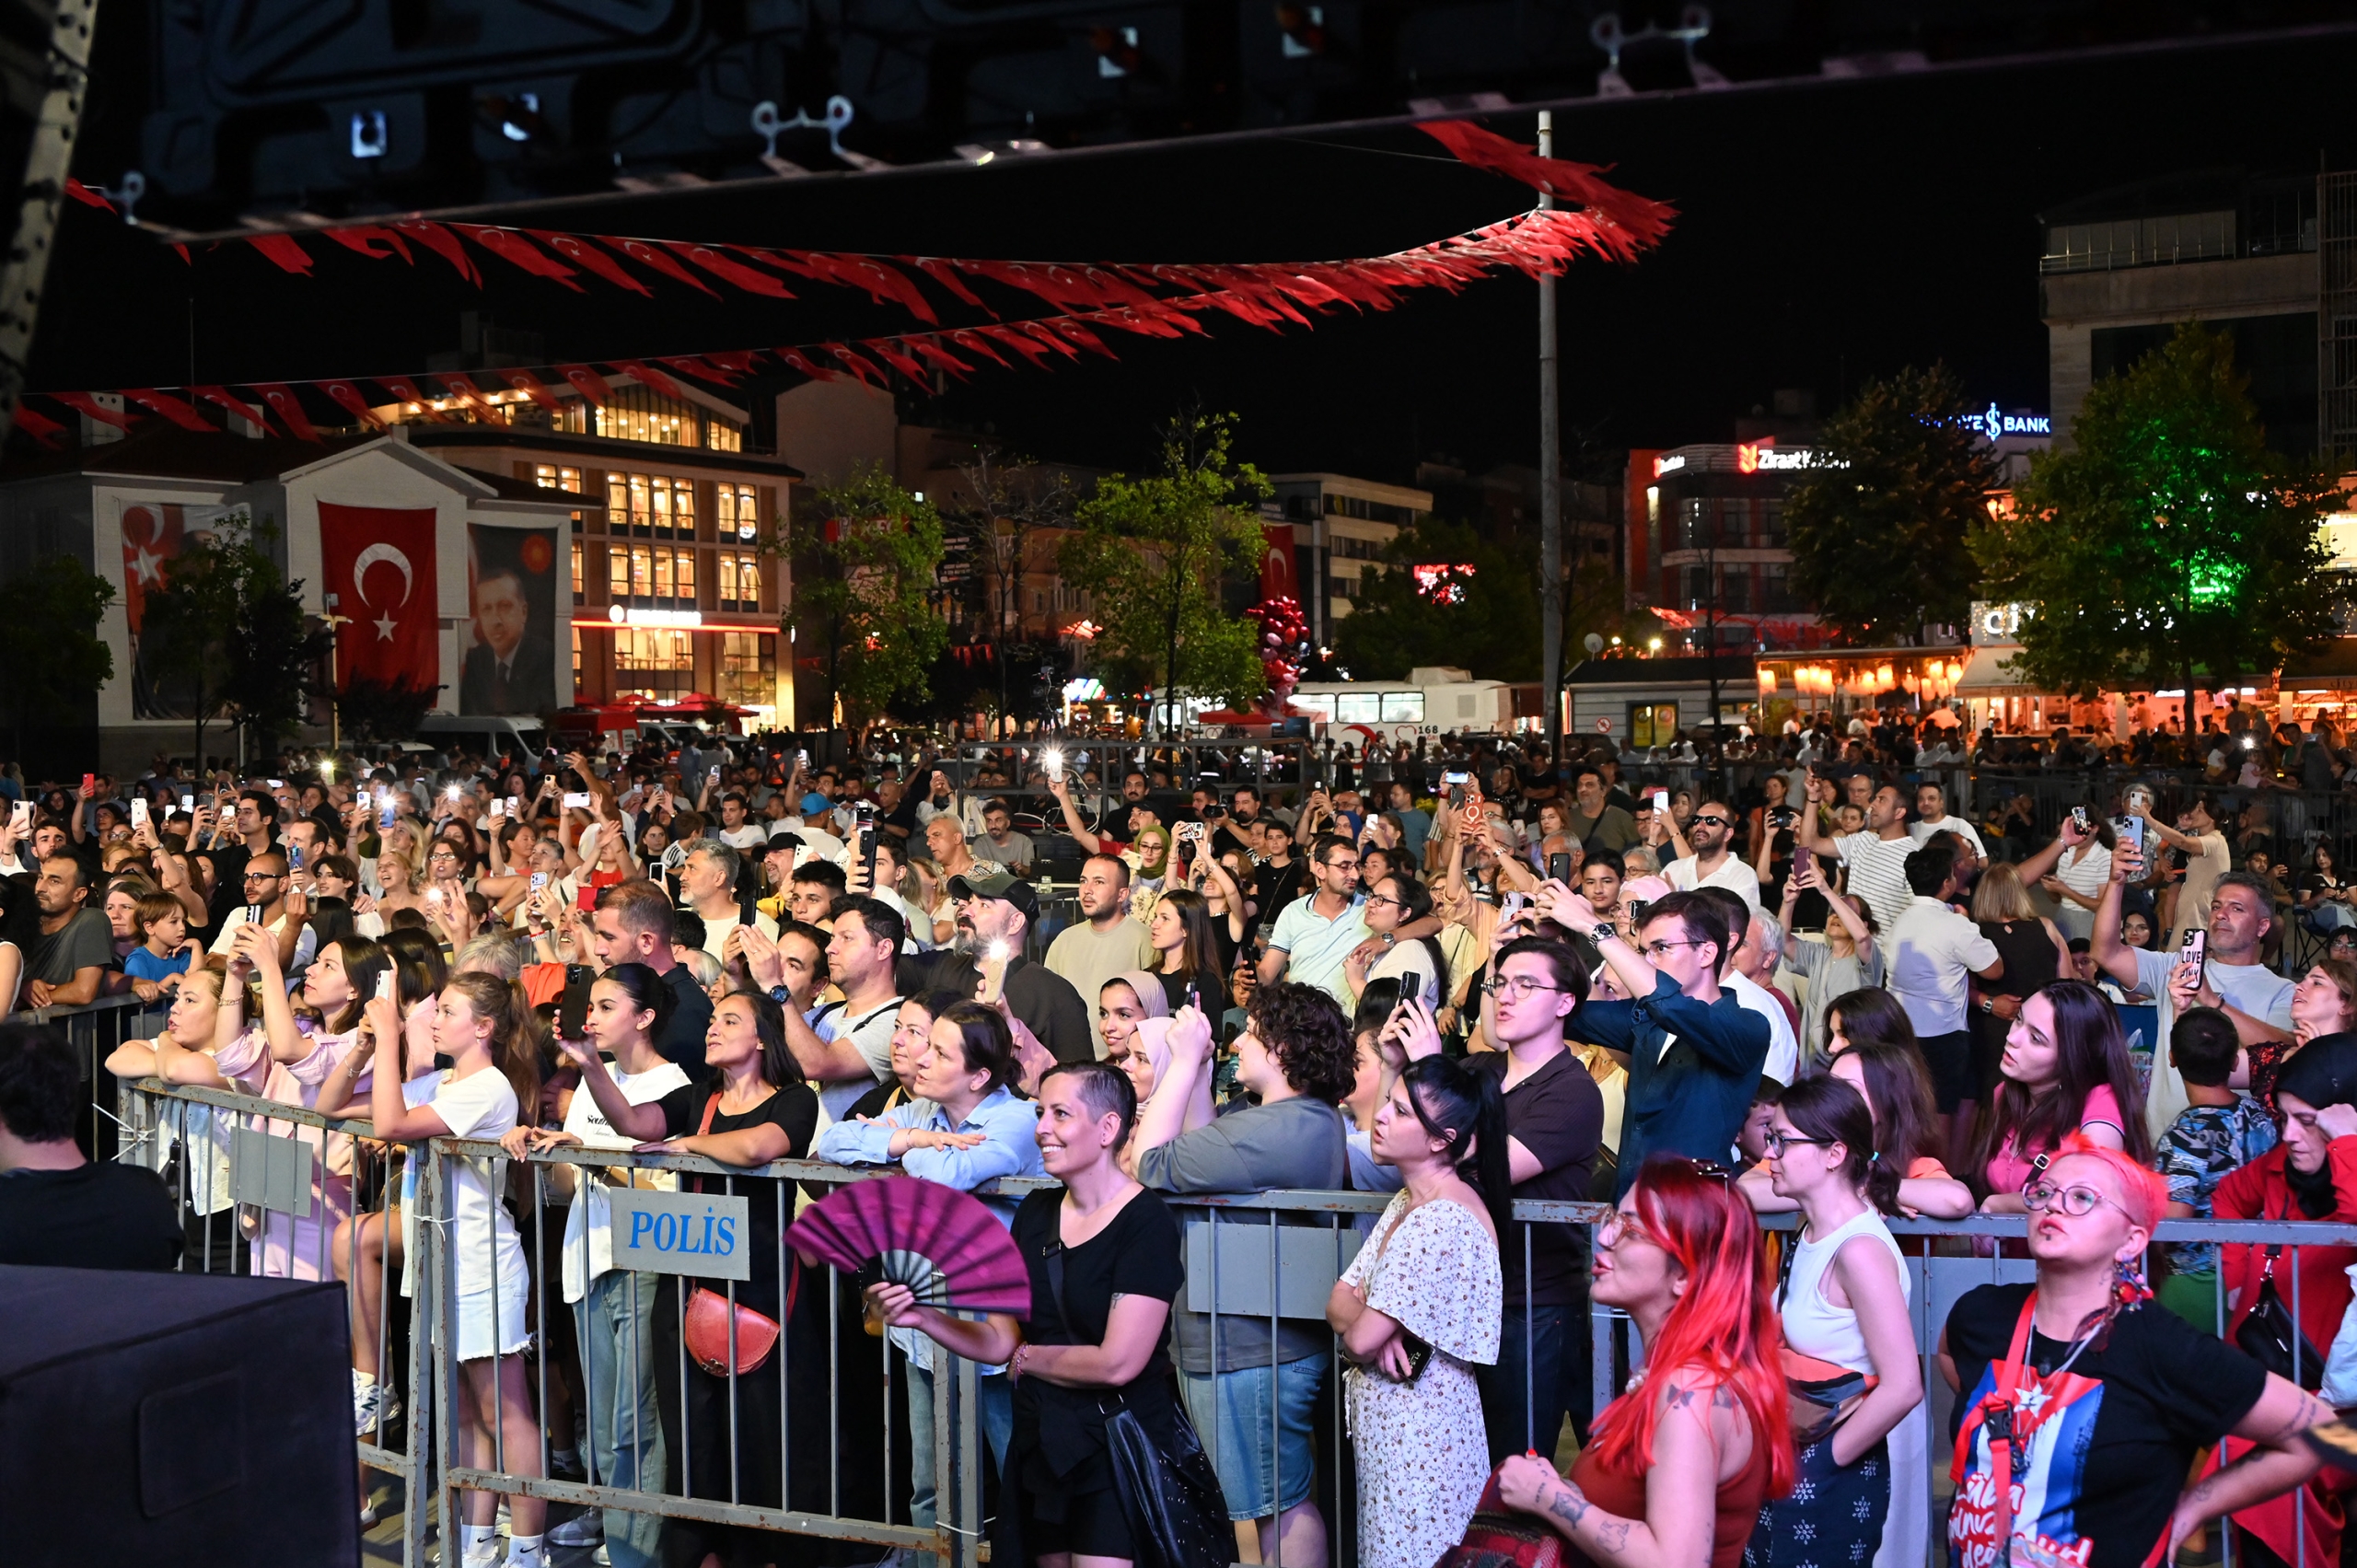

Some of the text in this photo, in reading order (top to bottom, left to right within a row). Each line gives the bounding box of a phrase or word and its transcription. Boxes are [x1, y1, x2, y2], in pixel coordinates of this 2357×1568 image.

[2003, 416, 2050, 433] BANK
[1758, 449, 1802, 469] Ziraat
[1419, 726, 1438, 734] 168
[2182, 951, 2200, 963] LOVE
[629, 1207, 735, 1256] POLİS
